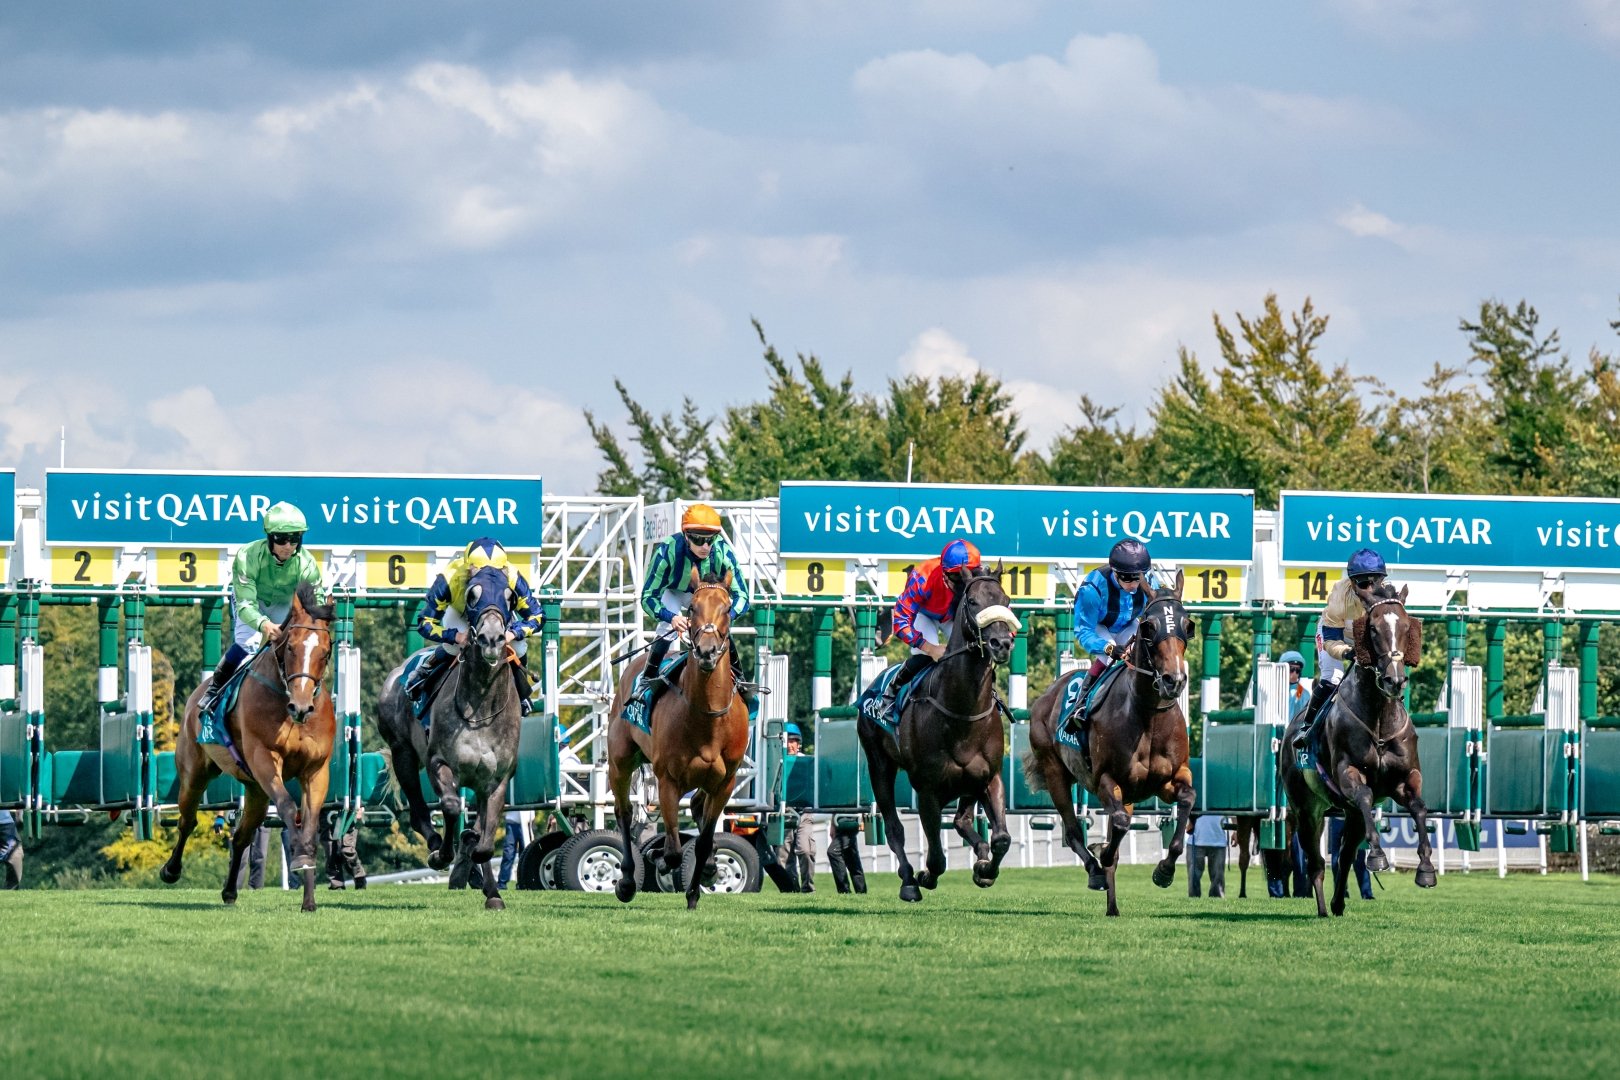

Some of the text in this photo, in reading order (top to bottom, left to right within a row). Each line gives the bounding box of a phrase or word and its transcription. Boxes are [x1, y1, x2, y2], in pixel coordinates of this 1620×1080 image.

[74, 550, 92, 582] 2
[179, 551, 197, 583] 3
[388, 554, 406, 586] 6
[807, 561, 825, 593] 8
[1007, 566, 1032, 596] 11
[1197, 569, 1228, 599] 13
[1298, 571, 1328, 600] 14
[1163, 606, 1176, 633] NEF
